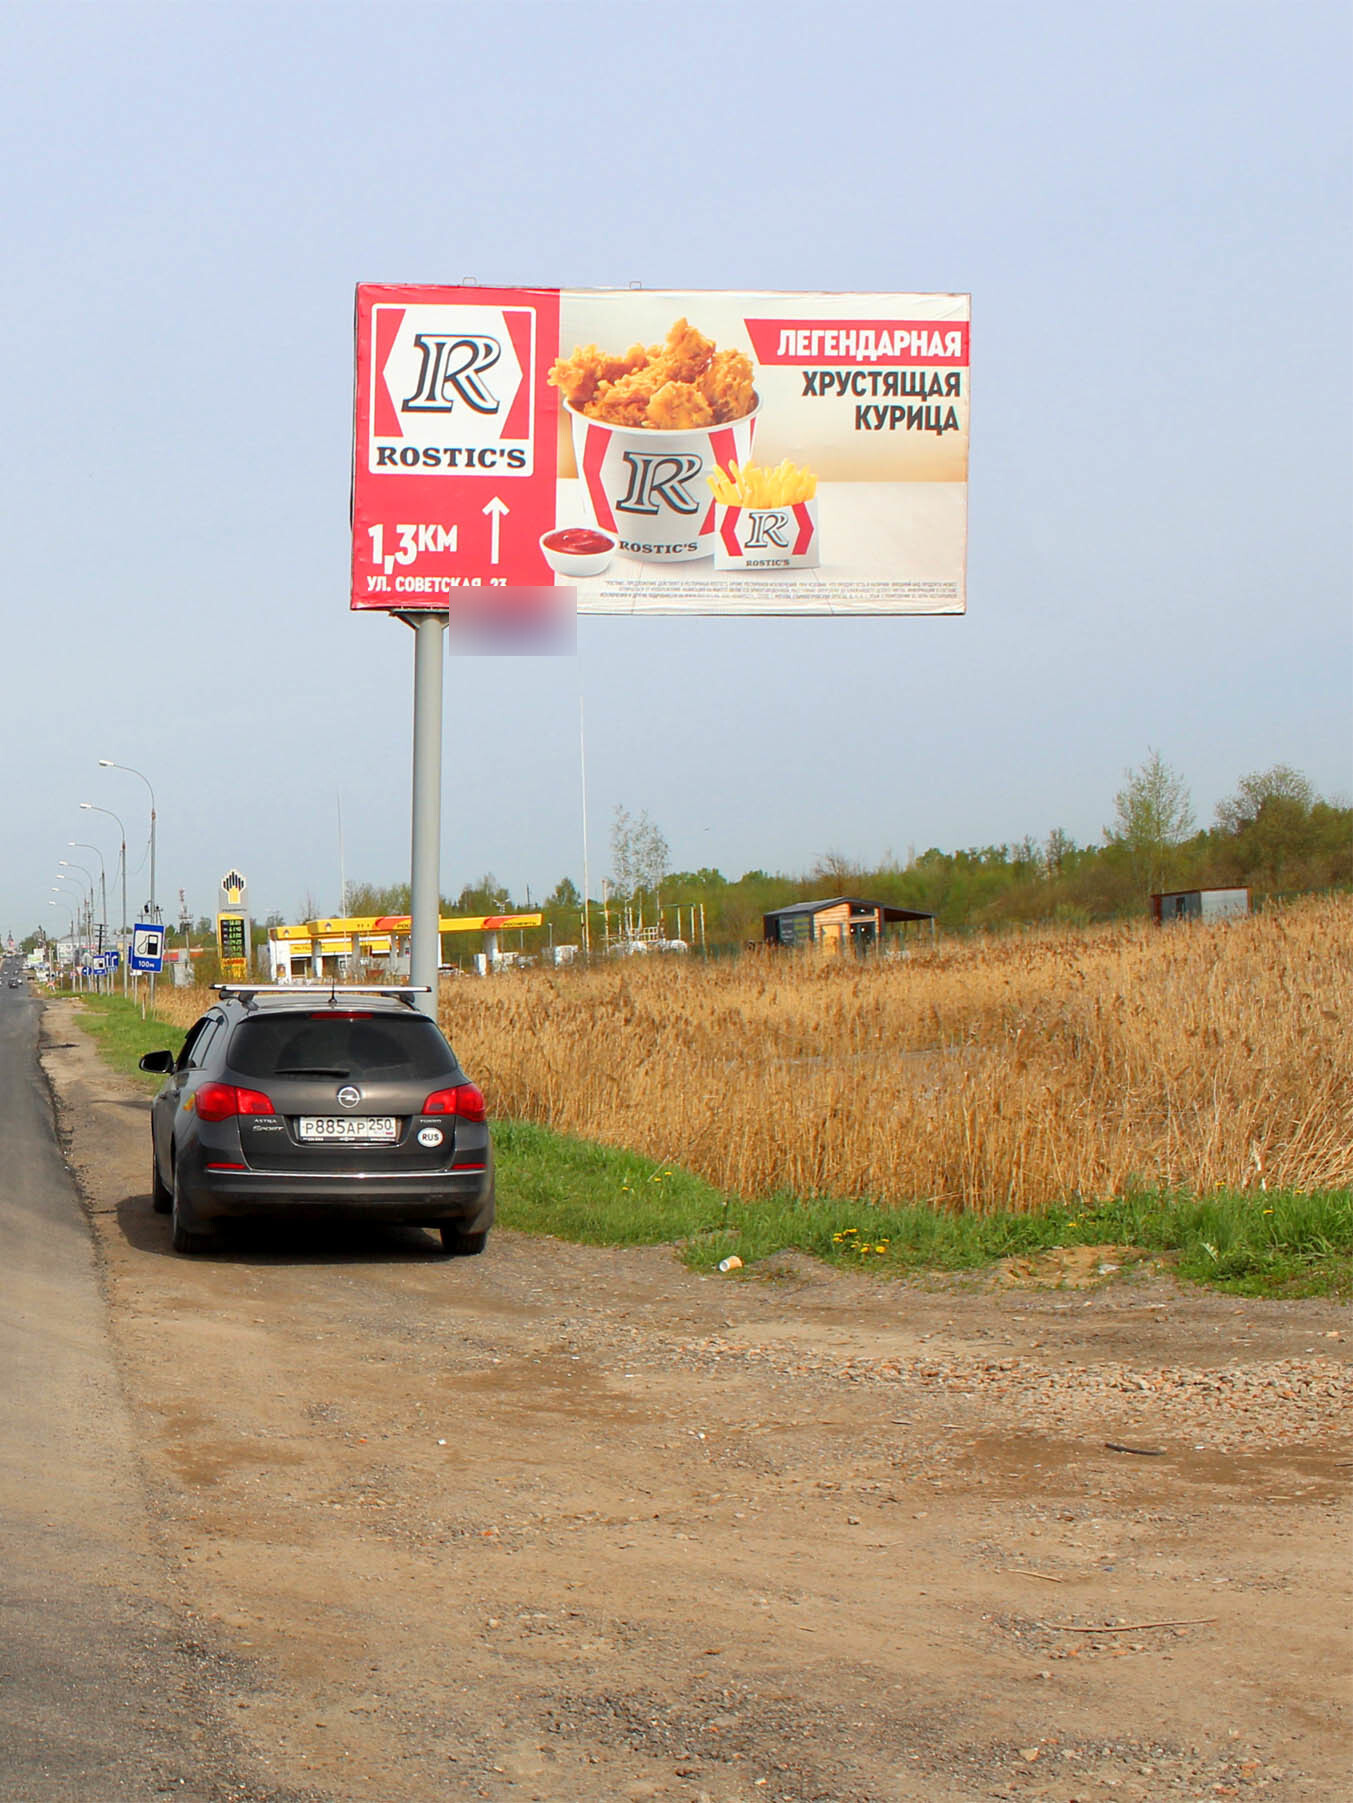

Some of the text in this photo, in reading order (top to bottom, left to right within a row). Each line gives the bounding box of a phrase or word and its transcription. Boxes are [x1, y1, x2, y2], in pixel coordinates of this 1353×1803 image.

[776, 329, 962, 361] ЛЕГЕНДАРНАЯ
[801, 370, 961, 402] ХРУСТЯЩАЯ
[854, 404, 960, 436] КУРИЦА
[376, 446, 527, 469] ROSTIC'S
[619, 540, 698, 555] ROSTIC'S
[745, 559, 790, 567] ROSTIC'S
[366, 575, 392, 592] УЛ.
[368, 1119, 392, 1131] 250
[422, 1133, 440, 1141] RUS
